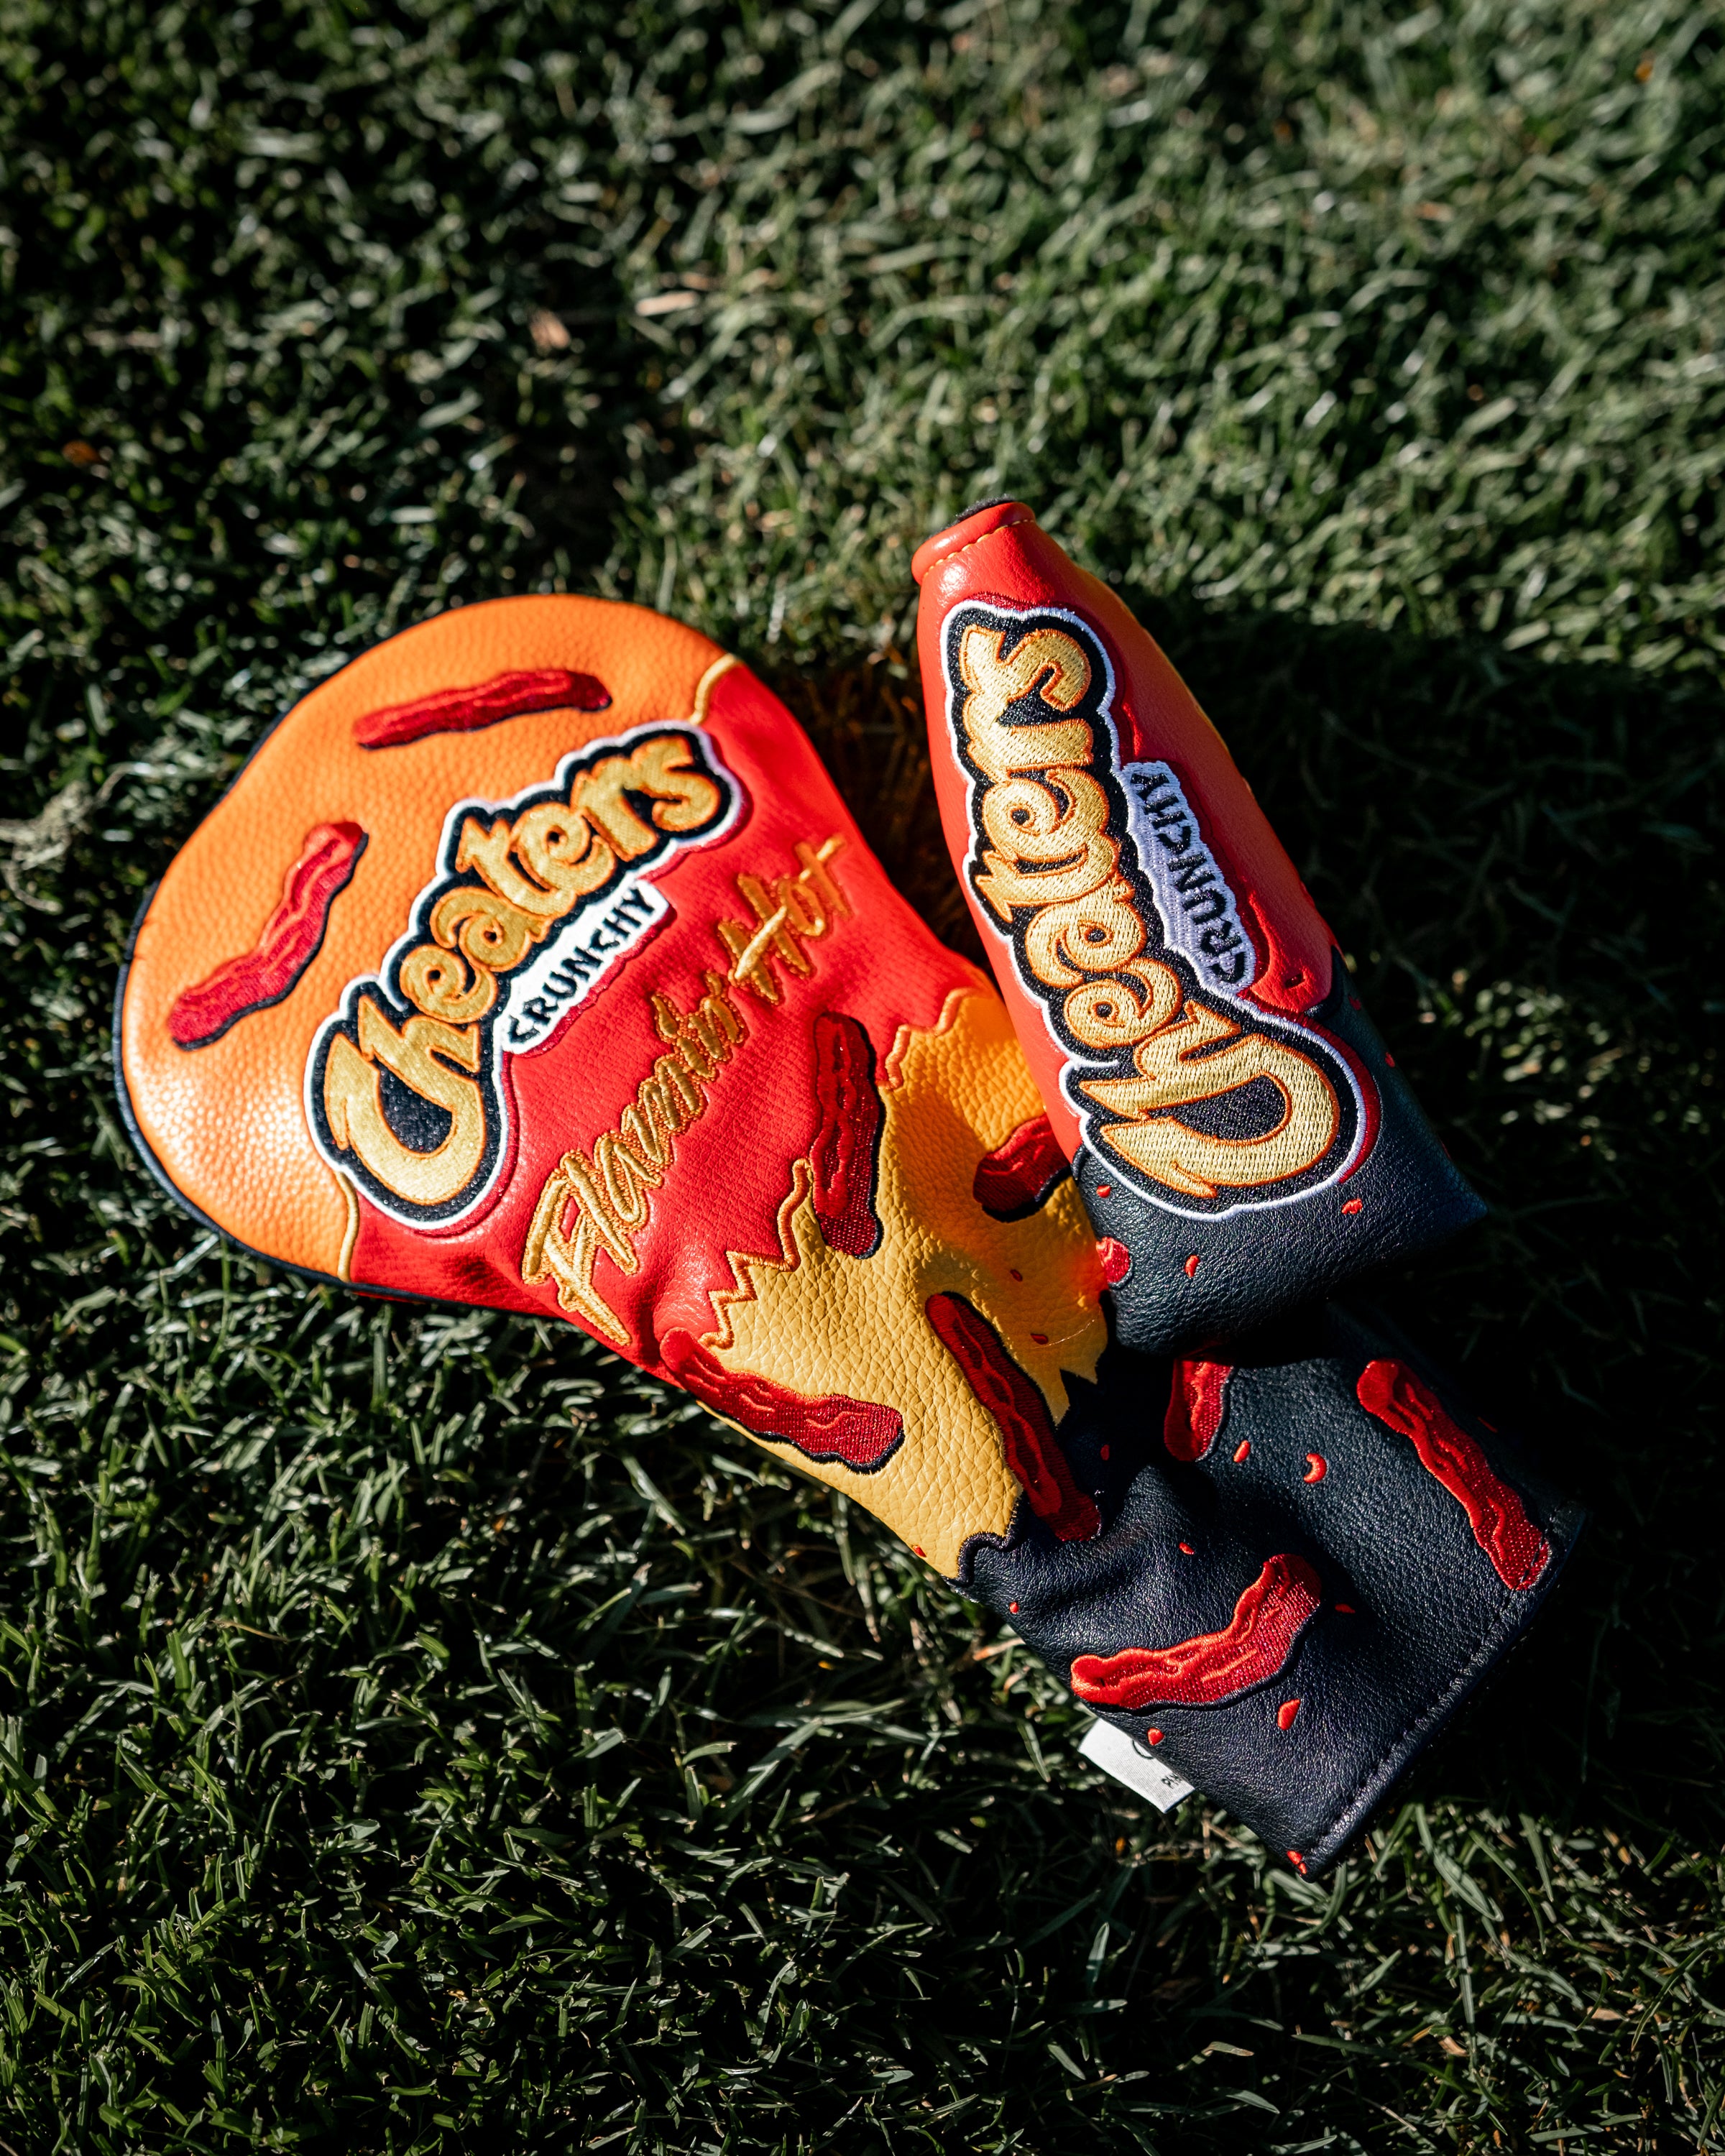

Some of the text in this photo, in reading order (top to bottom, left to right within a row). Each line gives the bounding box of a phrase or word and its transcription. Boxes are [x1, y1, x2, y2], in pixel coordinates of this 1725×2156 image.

[323, 734, 720, 1205] Cheaters
[507, 888, 656, 1044] CRUNCHY
[717, 833, 850, 1005] Hot
[957, 624, 1340, 1199] Cheaters
[1130, 772, 1248, 984] CRUNCHY
